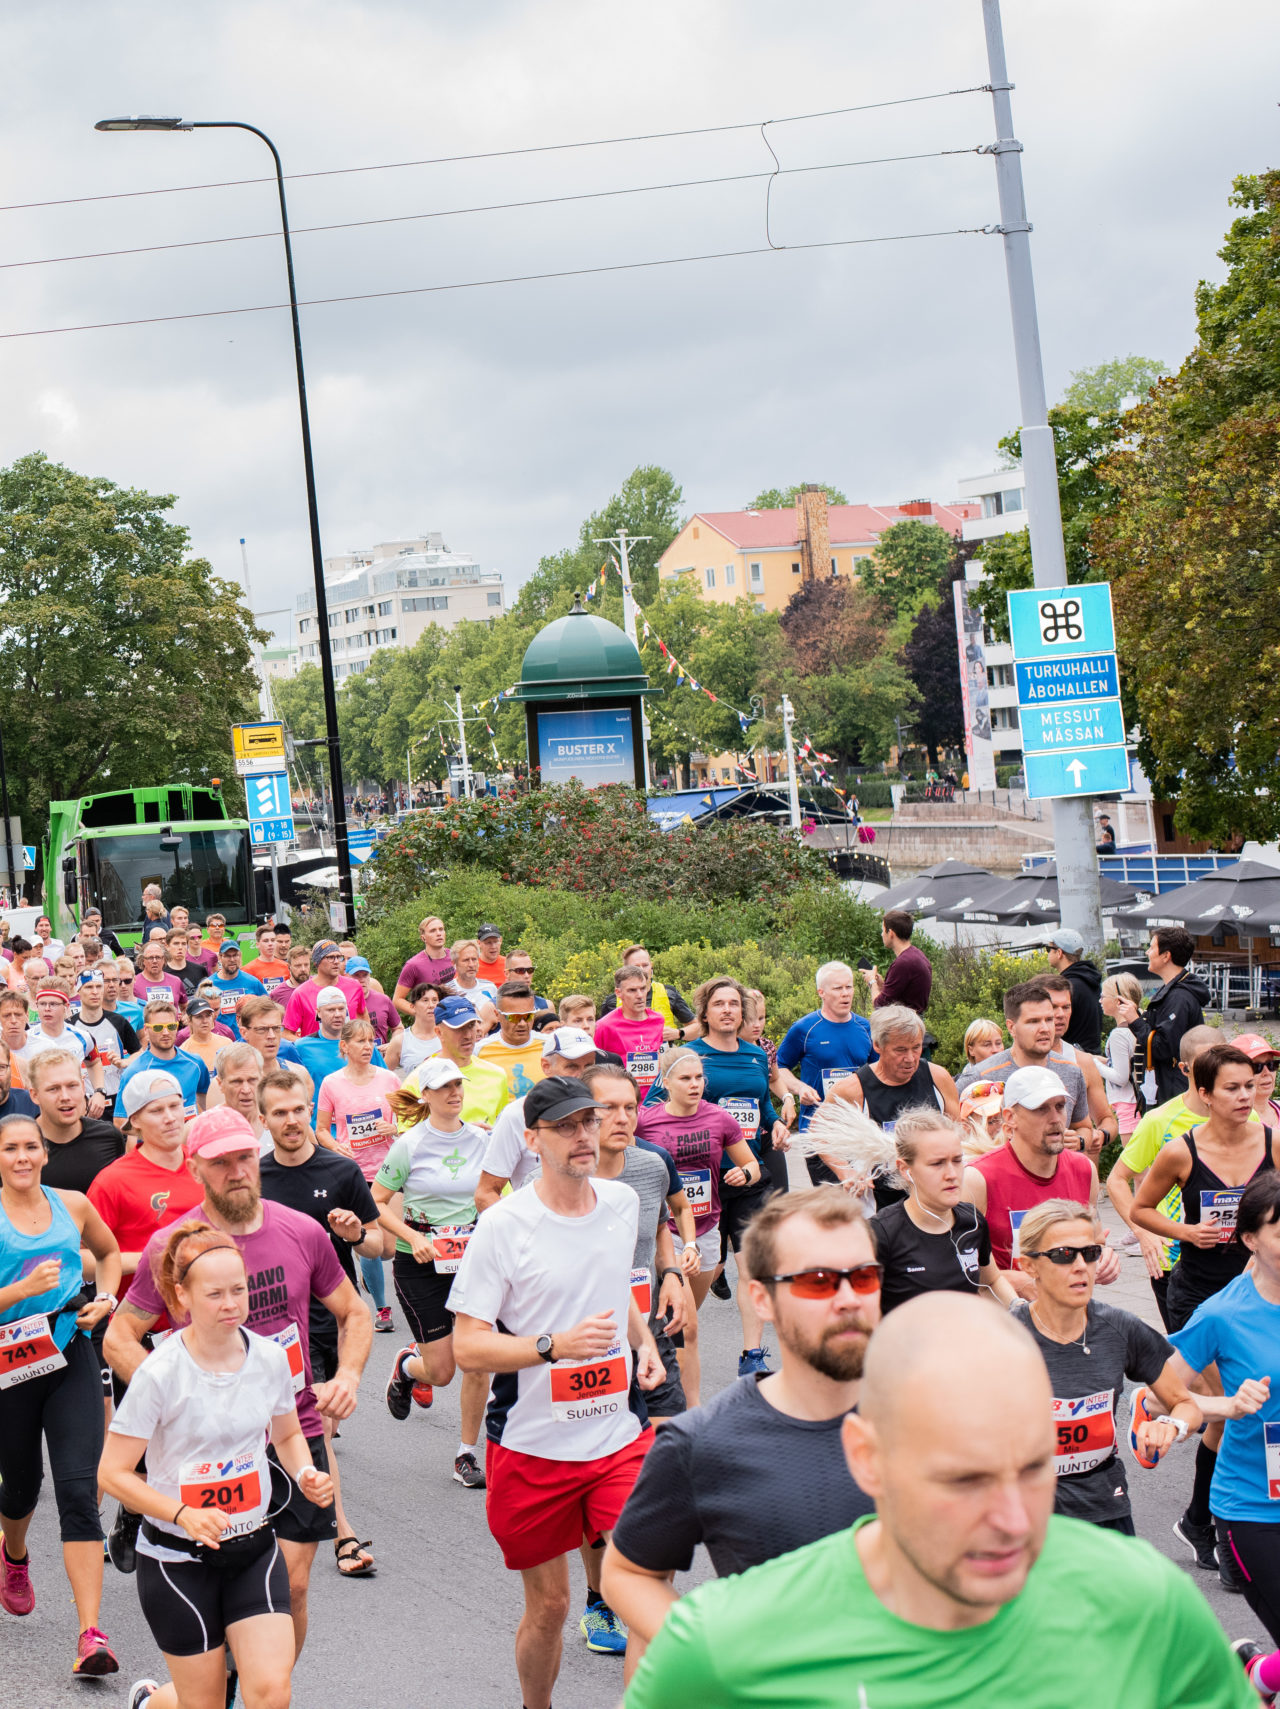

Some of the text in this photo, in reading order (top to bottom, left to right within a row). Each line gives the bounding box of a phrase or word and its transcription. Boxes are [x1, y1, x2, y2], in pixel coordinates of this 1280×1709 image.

[1025, 660, 1109, 679] TURKUHALLI
[1028, 680, 1108, 699] ÅBOHALLEN
[1041, 708, 1101, 726] MESSUT
[1042, 726, 1104, 744] MÄSSAN
[558, 743, 616, 756] BUSTER X
[270, 822, 275, 831] 9
[281, 821, 288, 829] 18
[282, 829, 292, 839] 15)
[630, 1063, 655, 1072] 2986
[677, 1129, 710, 1146] PAAVO
[677, 1141, 711, 1158] NURMI
[684, 1185, 704, 1198] 84
[247, 1265, 285, 1292] AAVO
[248, 1284, 288, 1312] URMI
[247, 1302, 288, 1323] ATHON
[2, 1343, 37, 1365] 741
[11, 1363, 55, 1384] SUUNTO
[569, 1368, 612, 1391] 302
[576, 1388, 606, 1400] Jerome
[1086, 1393, 1109, 1405] INTER
[567, 1402, 618, 1420] SUUNTO
[1086, 1401, 1108, 1412] SPORT
[1057, 1425, 1088, 1445] 50
[1064, 1445, 1080, 1453] Mia
[236, 1461, 254, 1473] SPORT
[200, 1482, 244, 1508] 201
